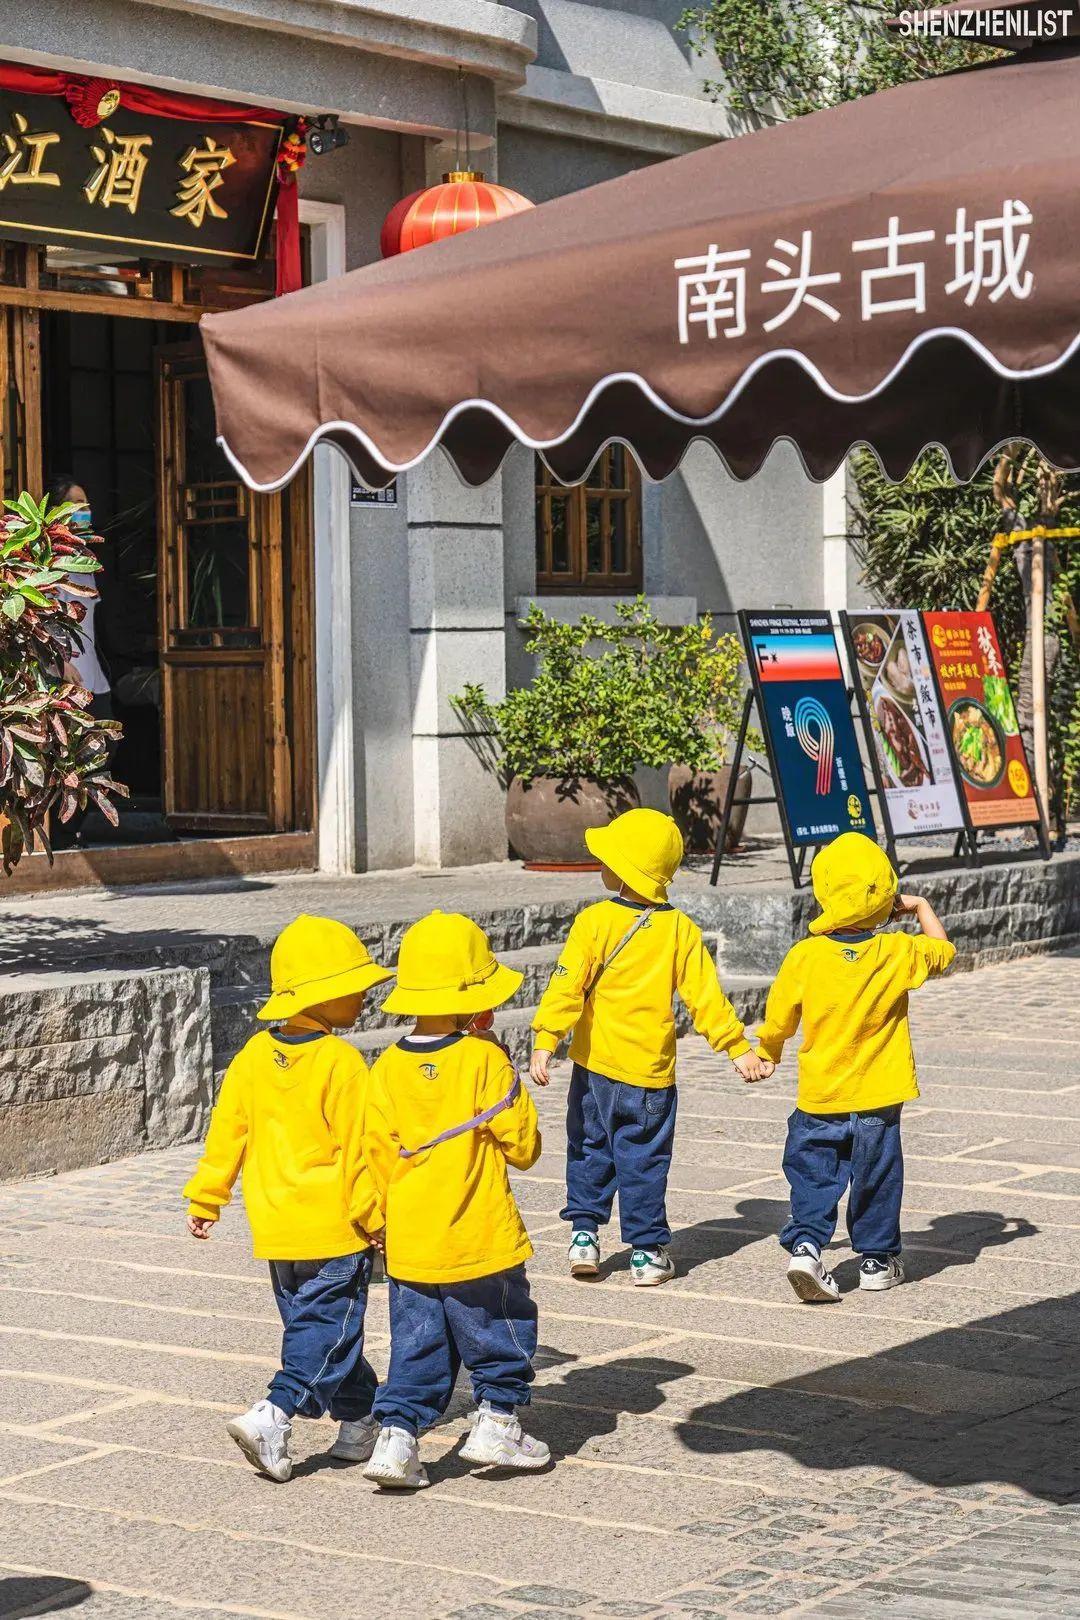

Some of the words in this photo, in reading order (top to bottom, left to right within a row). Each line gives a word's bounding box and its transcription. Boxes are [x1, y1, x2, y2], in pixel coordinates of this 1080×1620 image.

[0, 112, 239, 229] 江酒家
[674, 199, 1034, 344] 南头古城
[794, 696, 834, 796] 9
